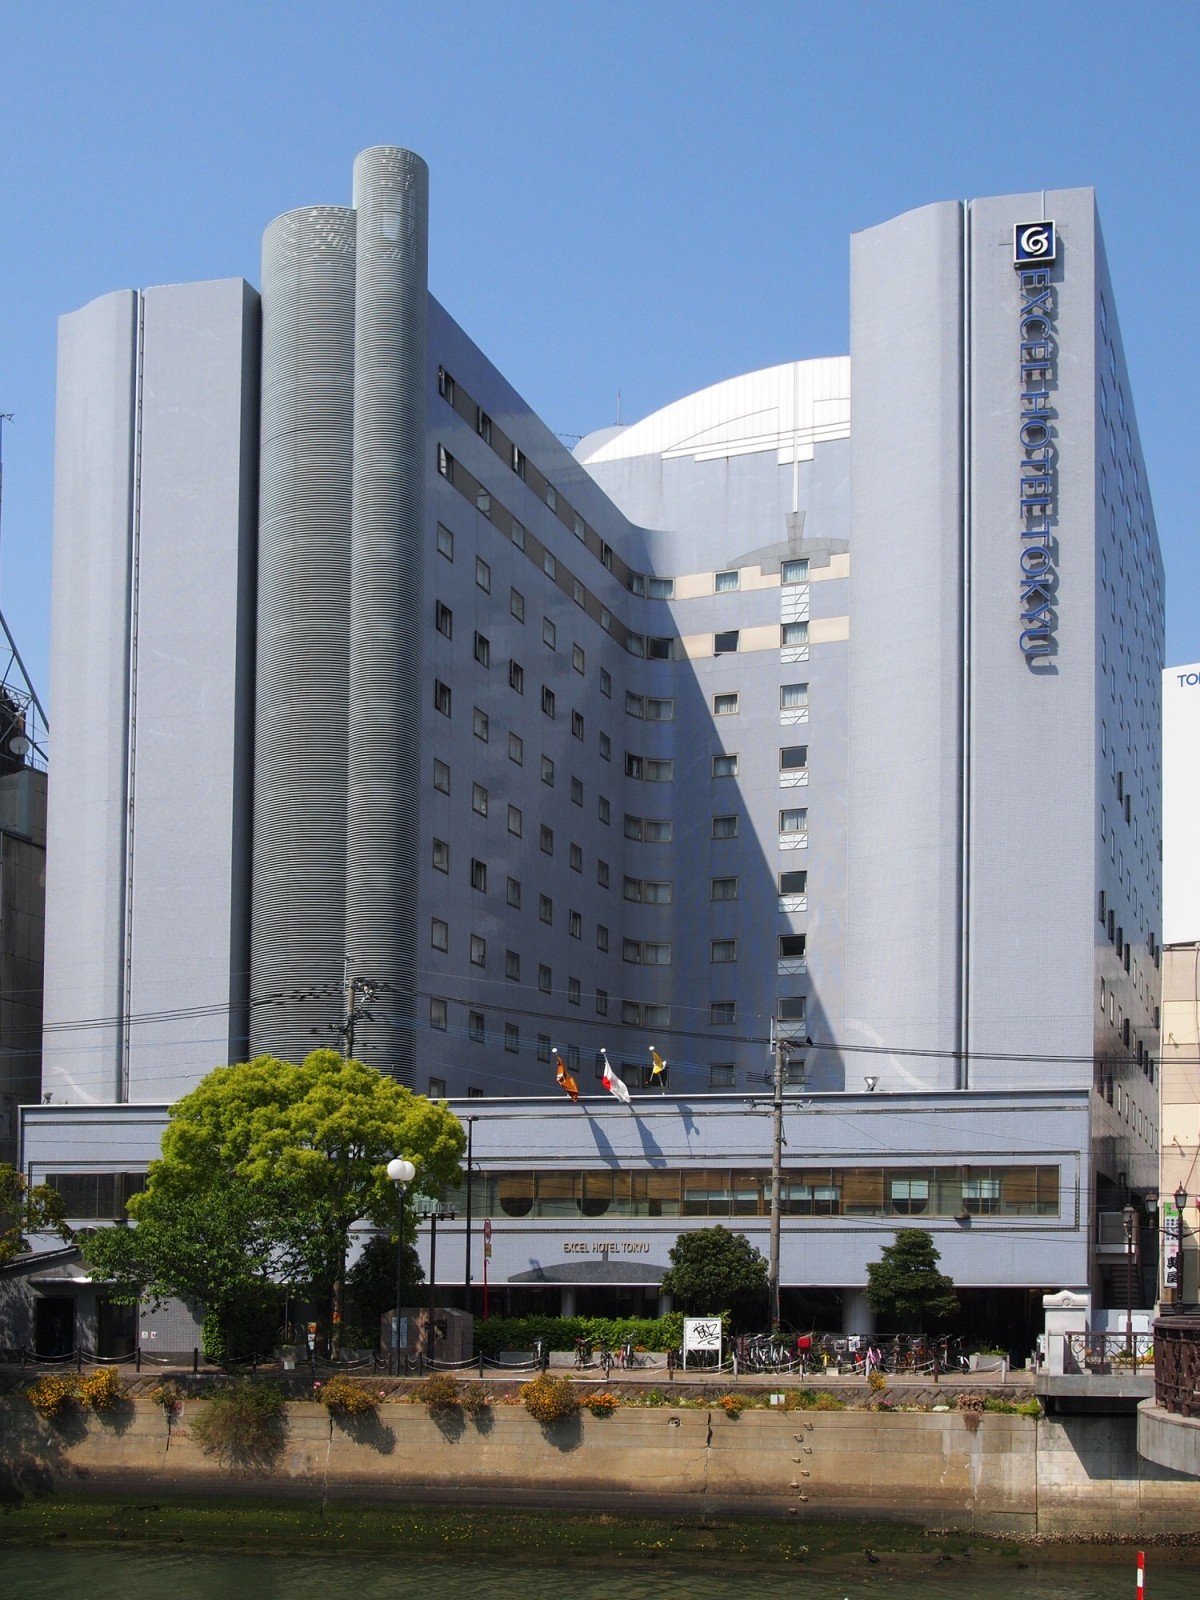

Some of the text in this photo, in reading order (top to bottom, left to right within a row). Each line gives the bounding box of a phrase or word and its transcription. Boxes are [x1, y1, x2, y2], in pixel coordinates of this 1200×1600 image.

[1019, 268, 1051, 654] EXCEL HOTEL TOKYU
[563, 1242, 650, 1254] EXCEL HOTEL TOKYU
